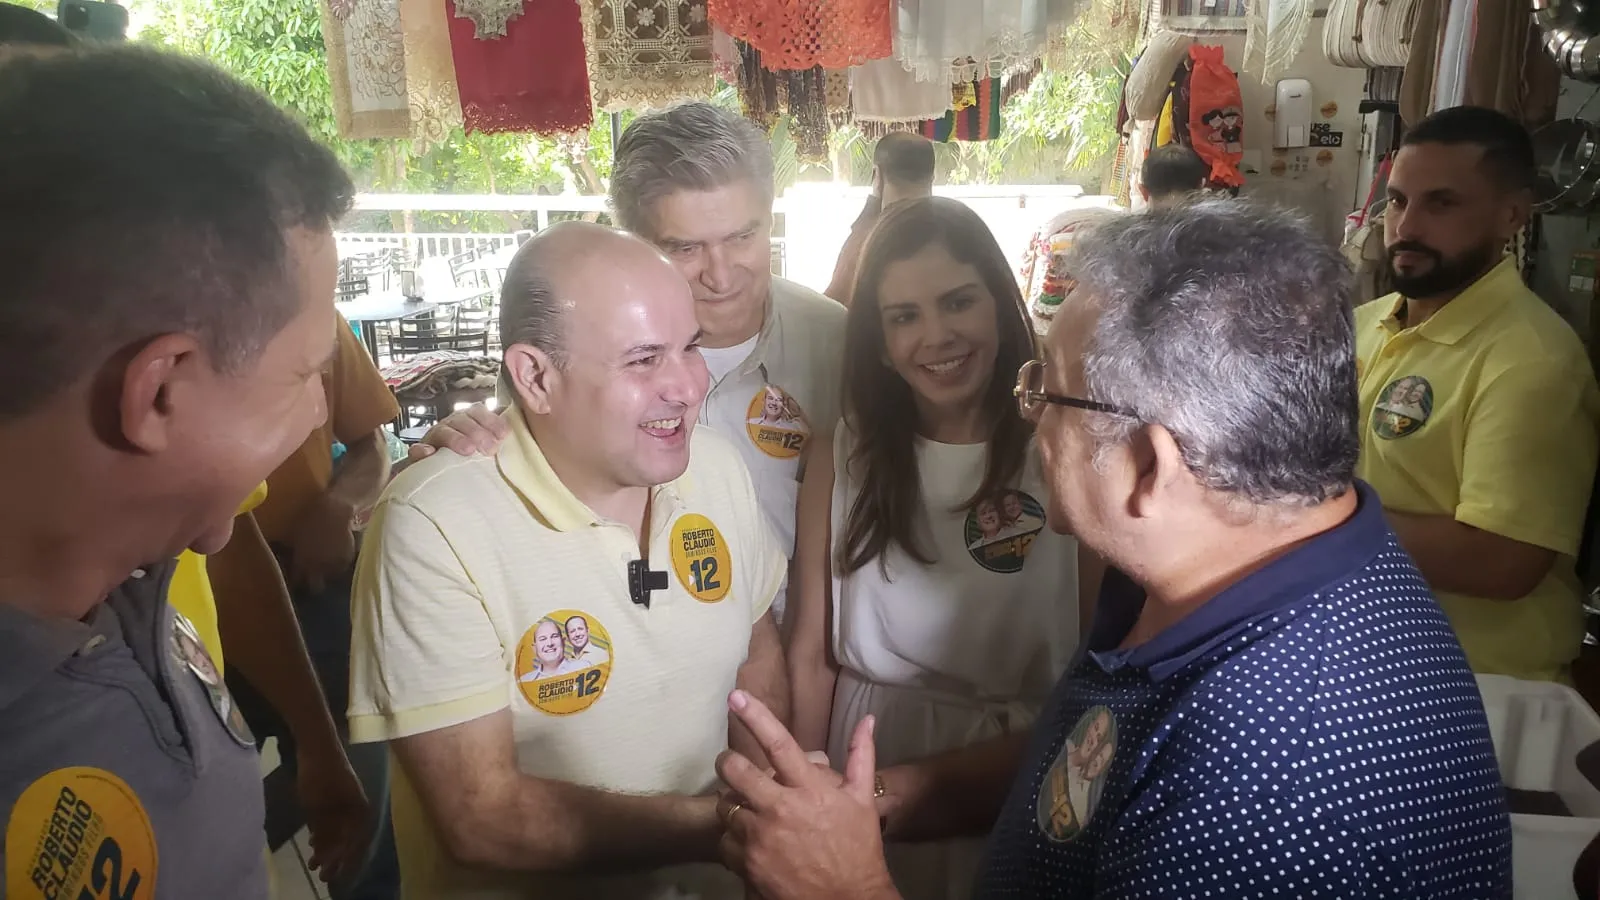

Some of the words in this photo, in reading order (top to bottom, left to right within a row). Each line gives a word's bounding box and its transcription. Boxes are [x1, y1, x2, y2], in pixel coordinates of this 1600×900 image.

[1320, 135, 1341, 145] elo
[783, 432, 804, 451] 12
[682, 528, 714, 542] ROBERTO
[683, 537, 715, 551] CLAUDIO
[690, 556, 721, 592] 12
[539, 678, 575, 692] ROBERTO
[575, 669, 602, 698] 12
[538, 685, 574, 699] CLAUDIO
[31, 786, 77, 891] ROBERTO
[43, 799, 93, 900] CLAUDIO
